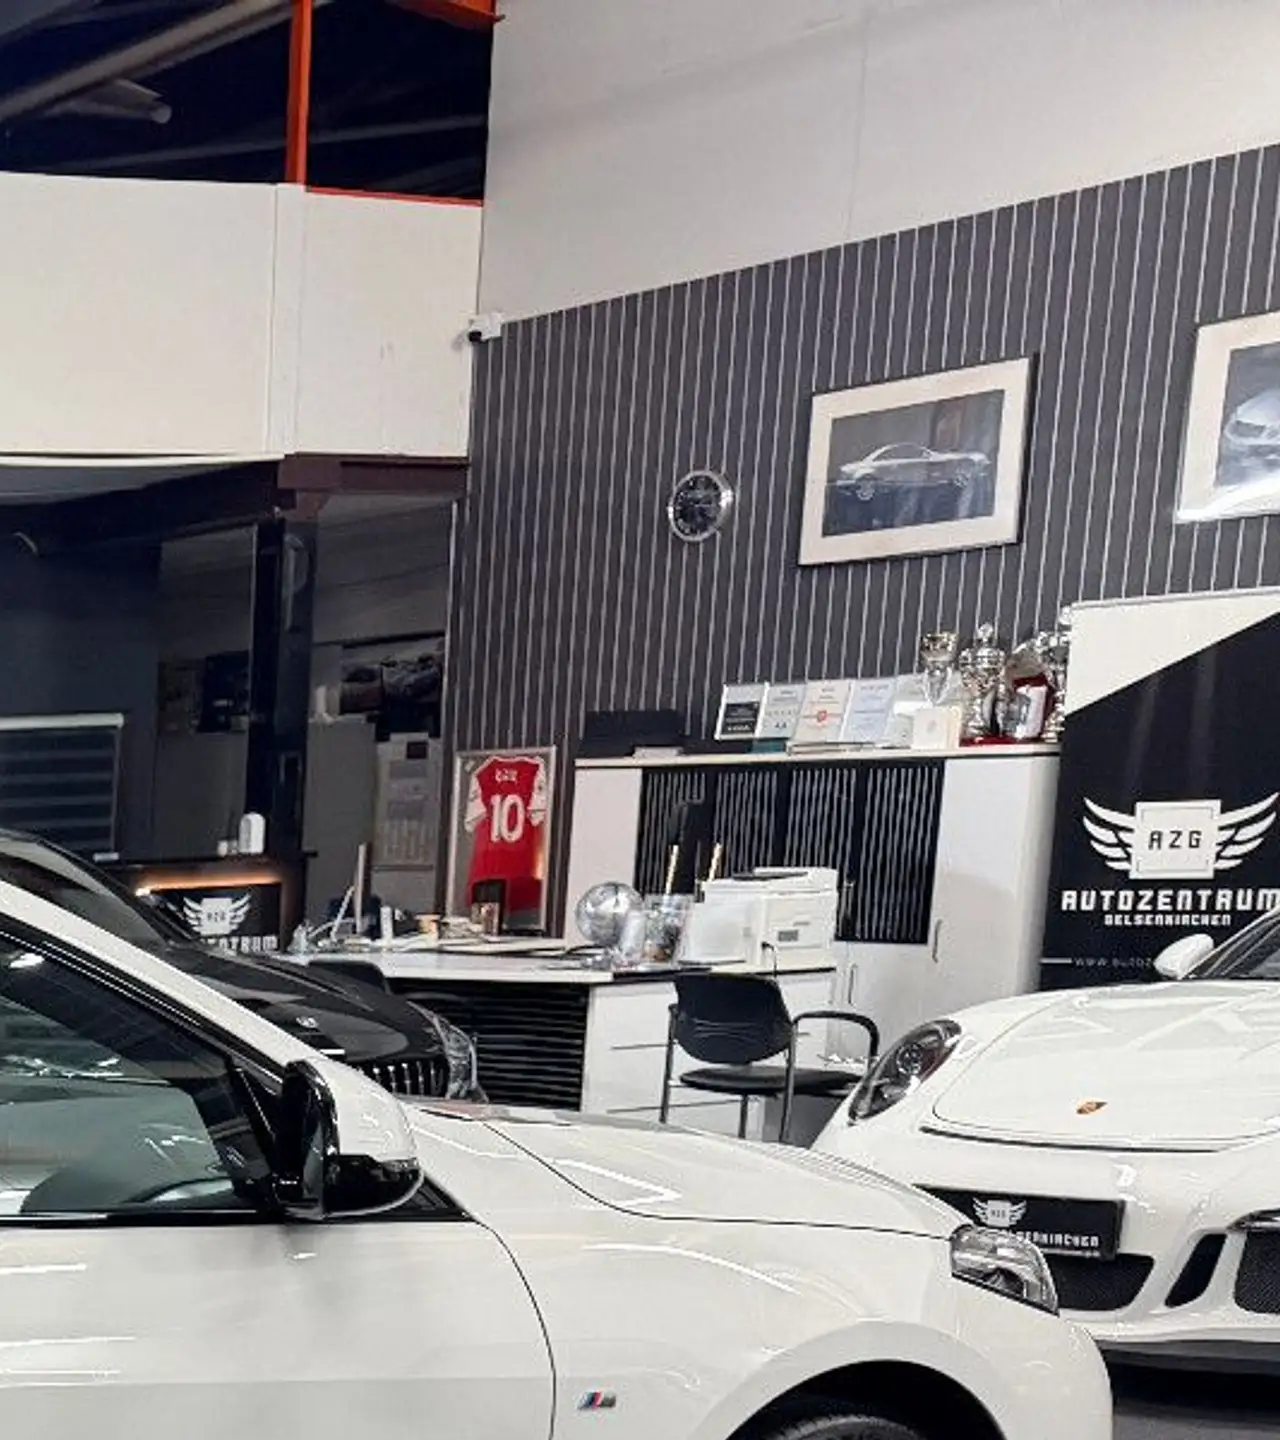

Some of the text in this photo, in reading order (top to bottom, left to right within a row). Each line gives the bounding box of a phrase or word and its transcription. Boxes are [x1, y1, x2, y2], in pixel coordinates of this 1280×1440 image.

[490, 794, 525, 843] 10
[1148, 830, 1203, 850] AZG
[1061, 888, 1280, 912] AUTOZENTRUM
[1104, 914, 1231, 926] GELSENKIRCHEN
